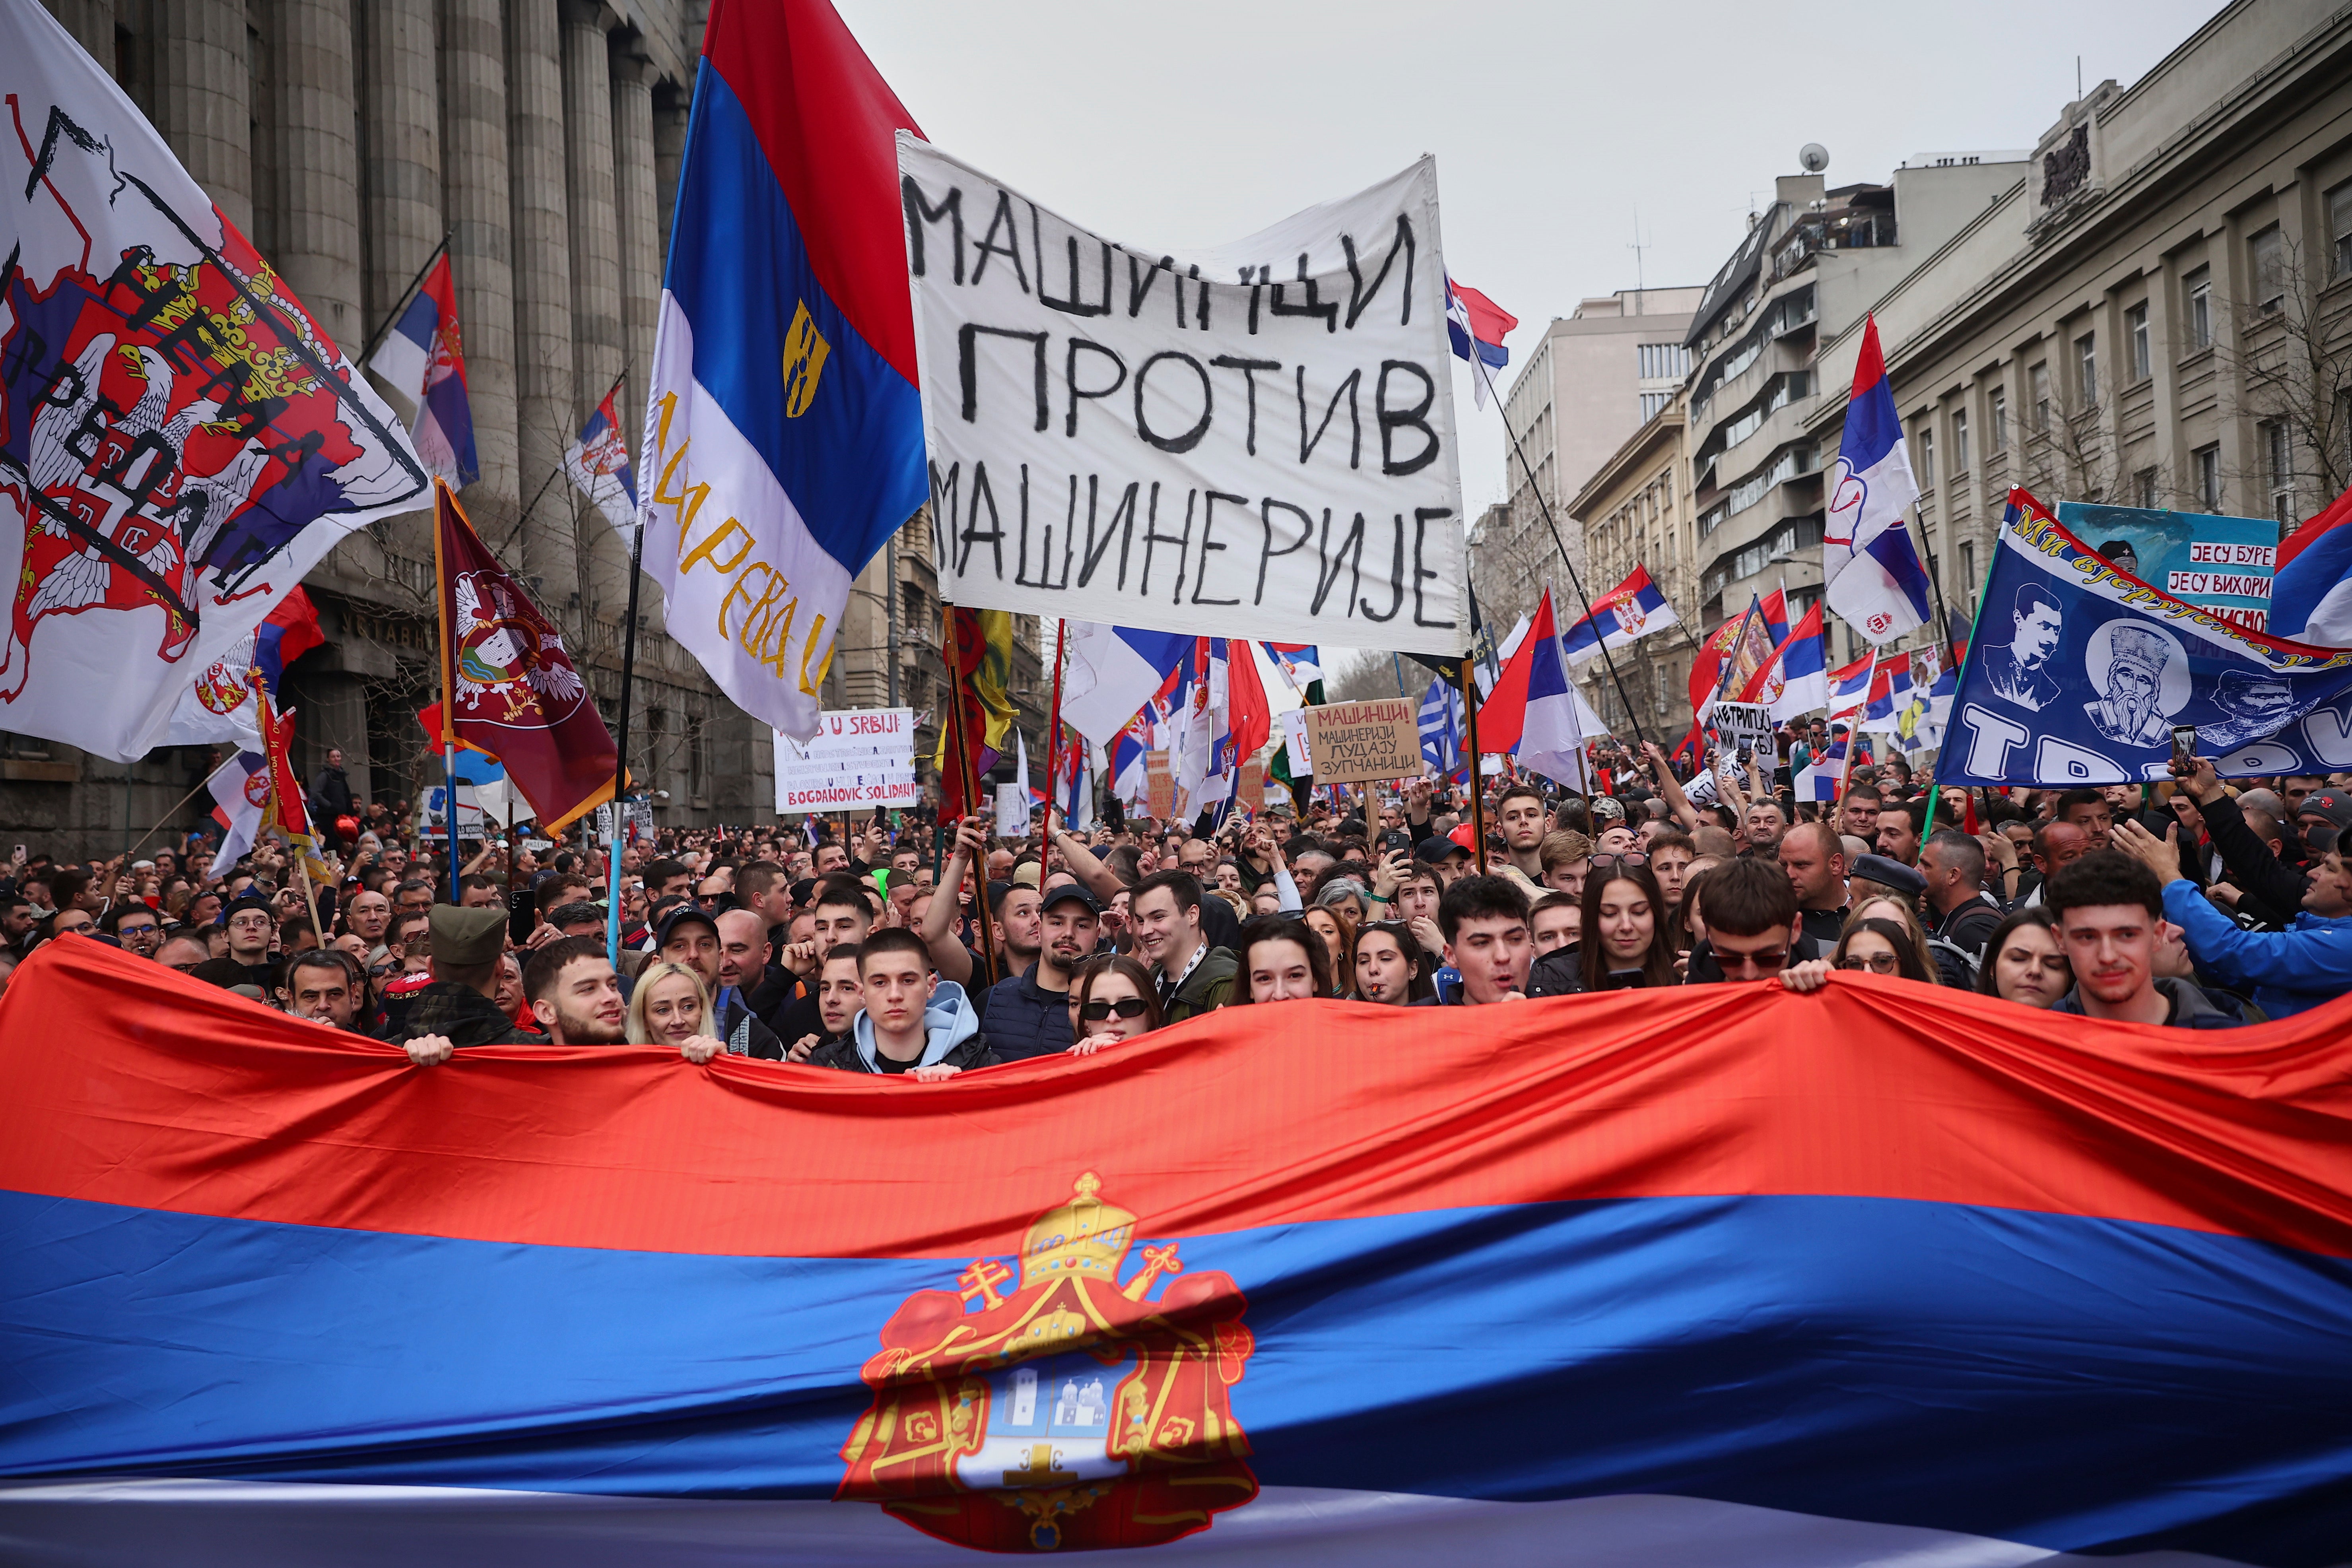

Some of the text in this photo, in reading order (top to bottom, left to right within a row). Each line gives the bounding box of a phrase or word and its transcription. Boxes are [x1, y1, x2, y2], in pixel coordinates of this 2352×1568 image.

[104, 245, 324, 490] НЕМА
[957, 322, 1439, 477] ПРОТИВ
[2012, 505, 2071, 557] Ми
[928, 457, 1457, 629] МАШИНЕРИЈЕ
[342, 612, 424, 650] УСТАВН
[830, 717, 842, 735] U
[849, 714, 901, 735] SRBIJI:
[1317, 704, 1410, 727] МАШИНЦИ!
[1319, 725, 1395, 745] МАШИНЕРИЈИ
[1330, 740, 1397, 759] ПУЦАЈУ
[1321, 754, 1416, 775] ЗУПЧАНИЦИ
[789, 783, 915, 806] BOGDANOVIĆ SOLIDAN!
